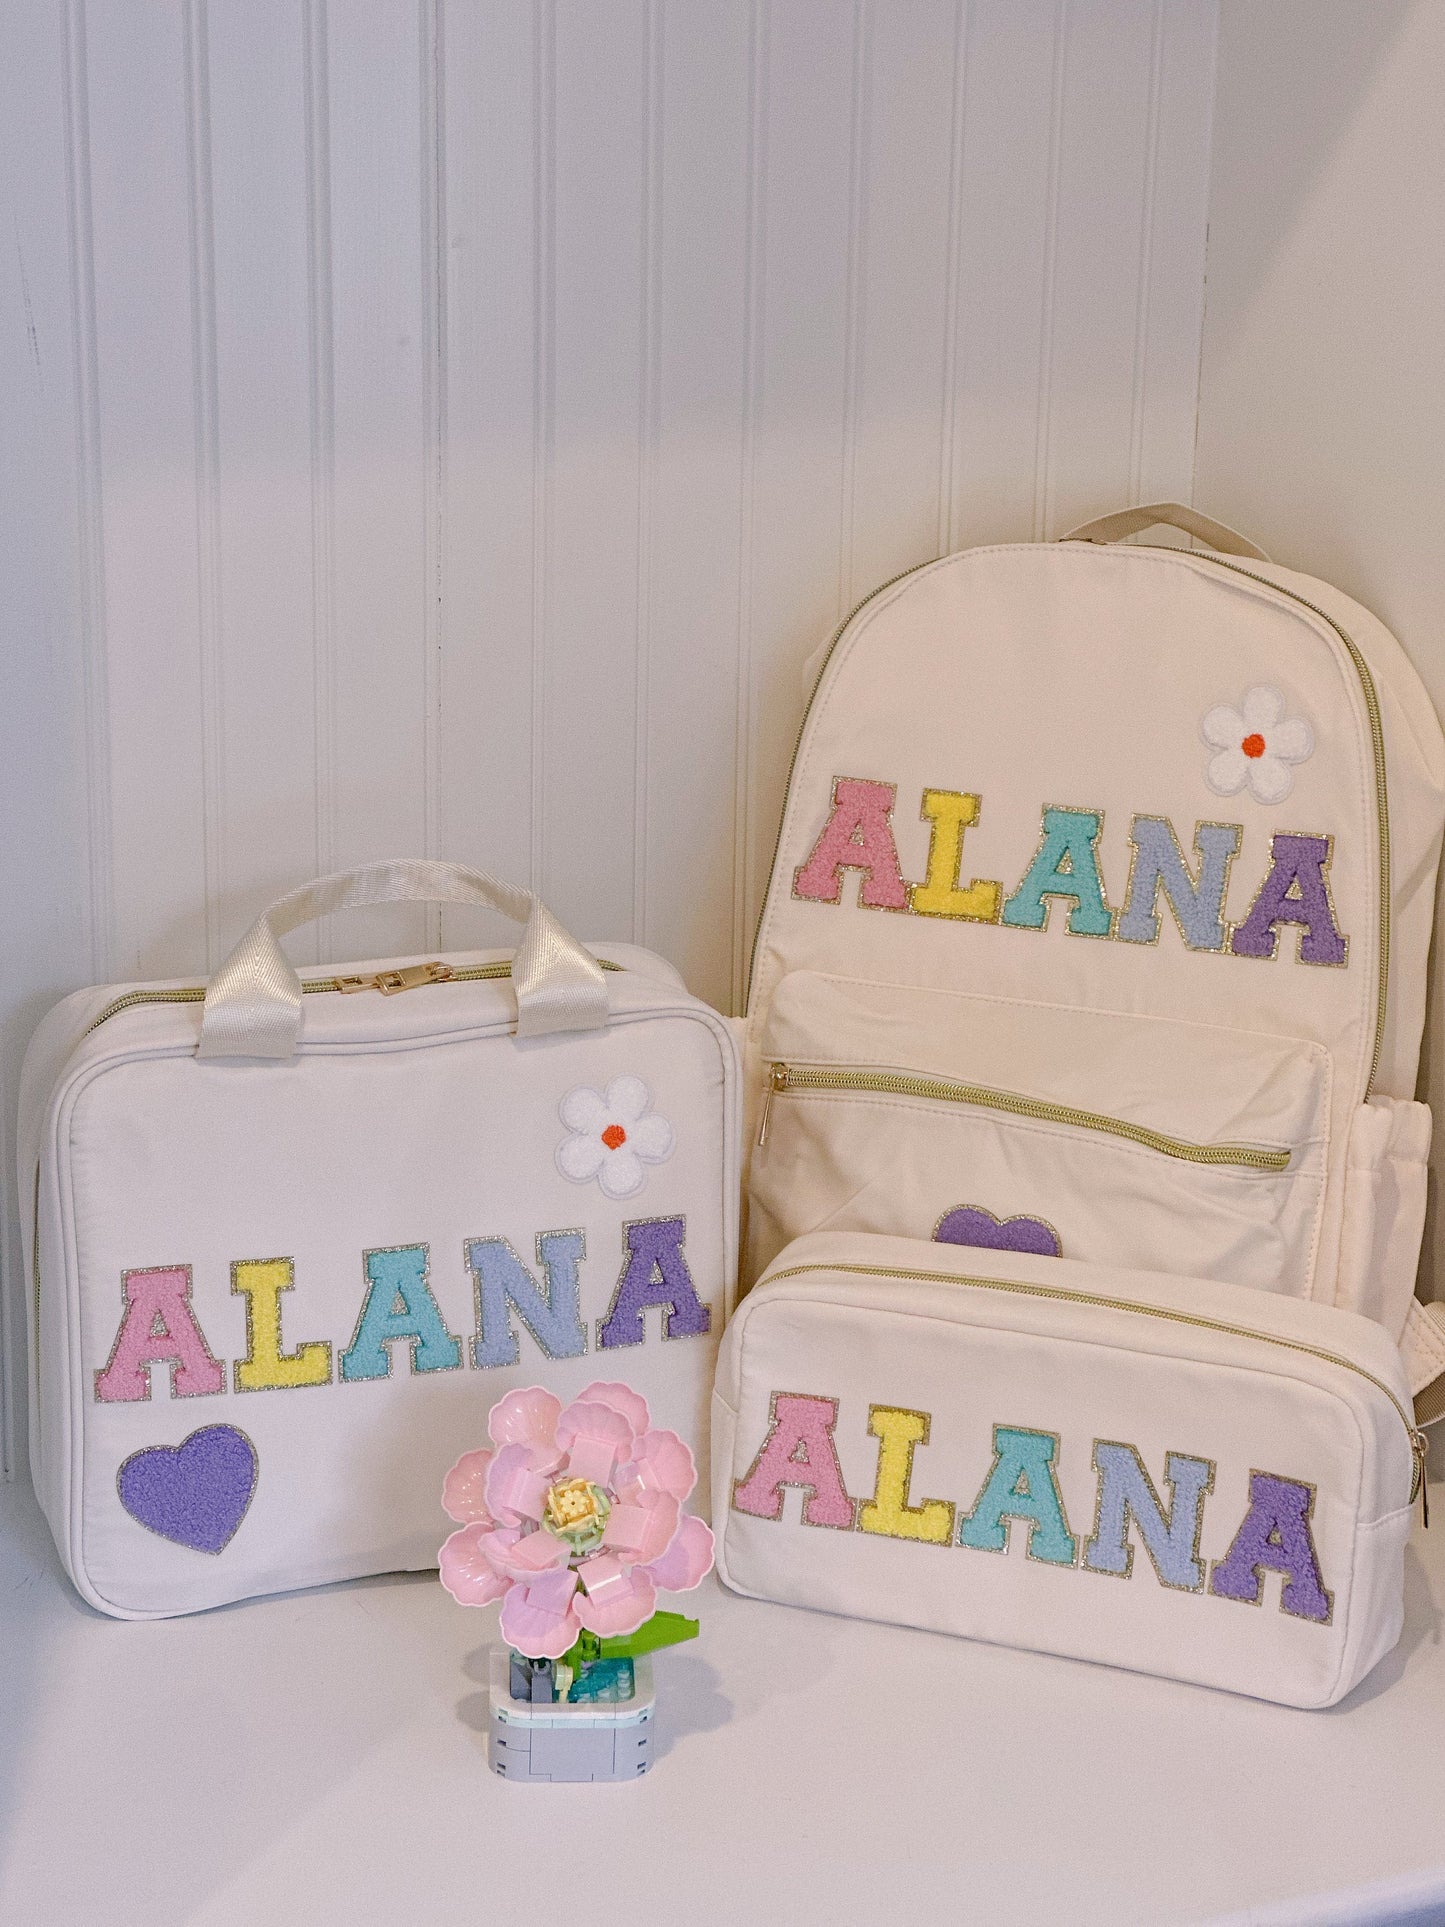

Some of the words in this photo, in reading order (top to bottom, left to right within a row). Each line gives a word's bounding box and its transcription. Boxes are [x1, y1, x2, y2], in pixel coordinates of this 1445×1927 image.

[791, 775, 1350, 968] ALANA
[94, 1213, 712, 1404] ALANA
[732, 1390, 1334, 1626] ALANA
